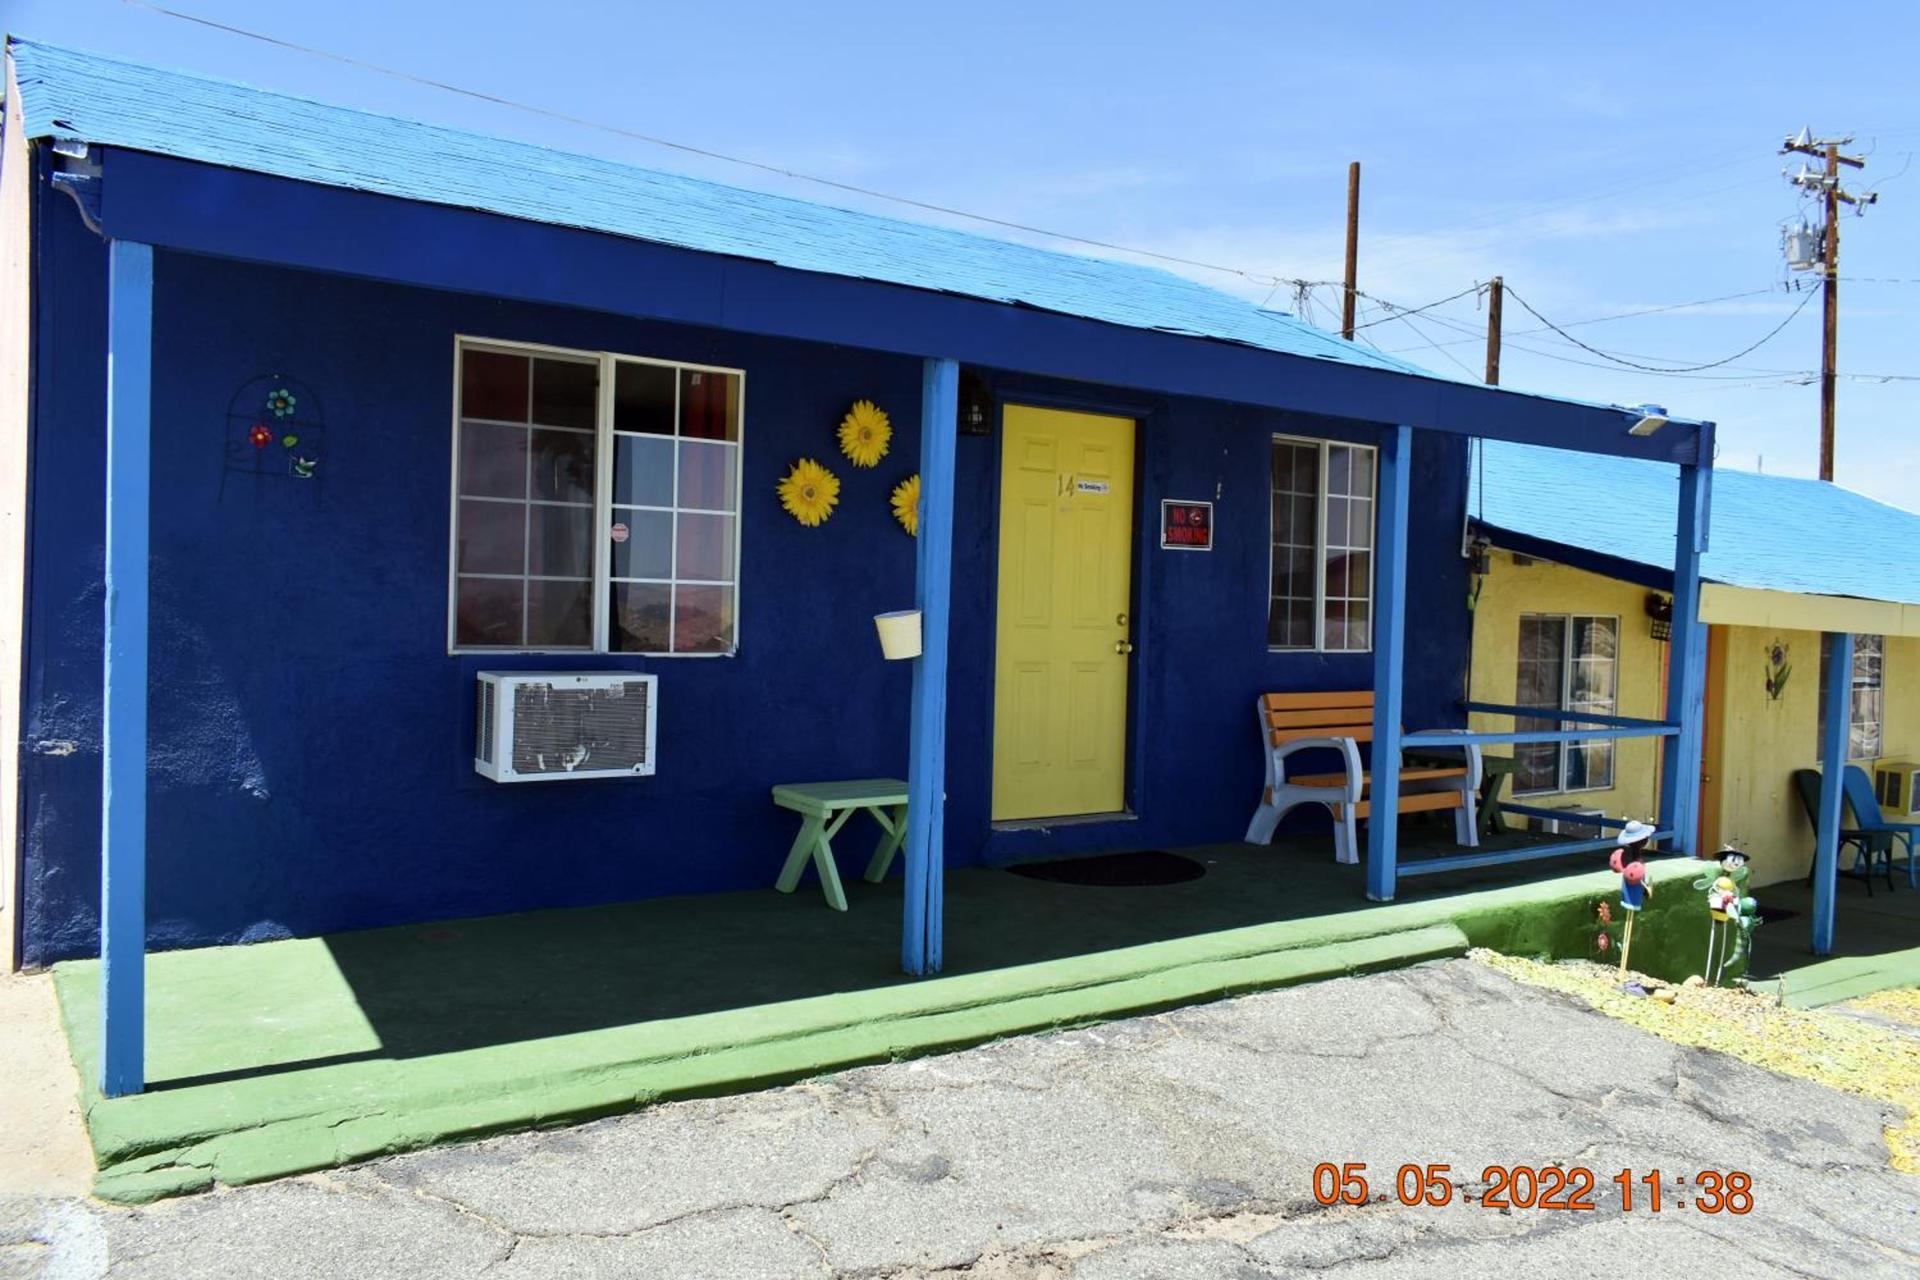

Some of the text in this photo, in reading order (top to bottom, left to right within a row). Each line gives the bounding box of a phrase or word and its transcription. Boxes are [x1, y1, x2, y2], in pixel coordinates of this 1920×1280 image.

[1058, 474, 1074, 497] 14
[1172, 506, 1185, 525] NO
[1167, 526, 1208, 544] SMOKING
